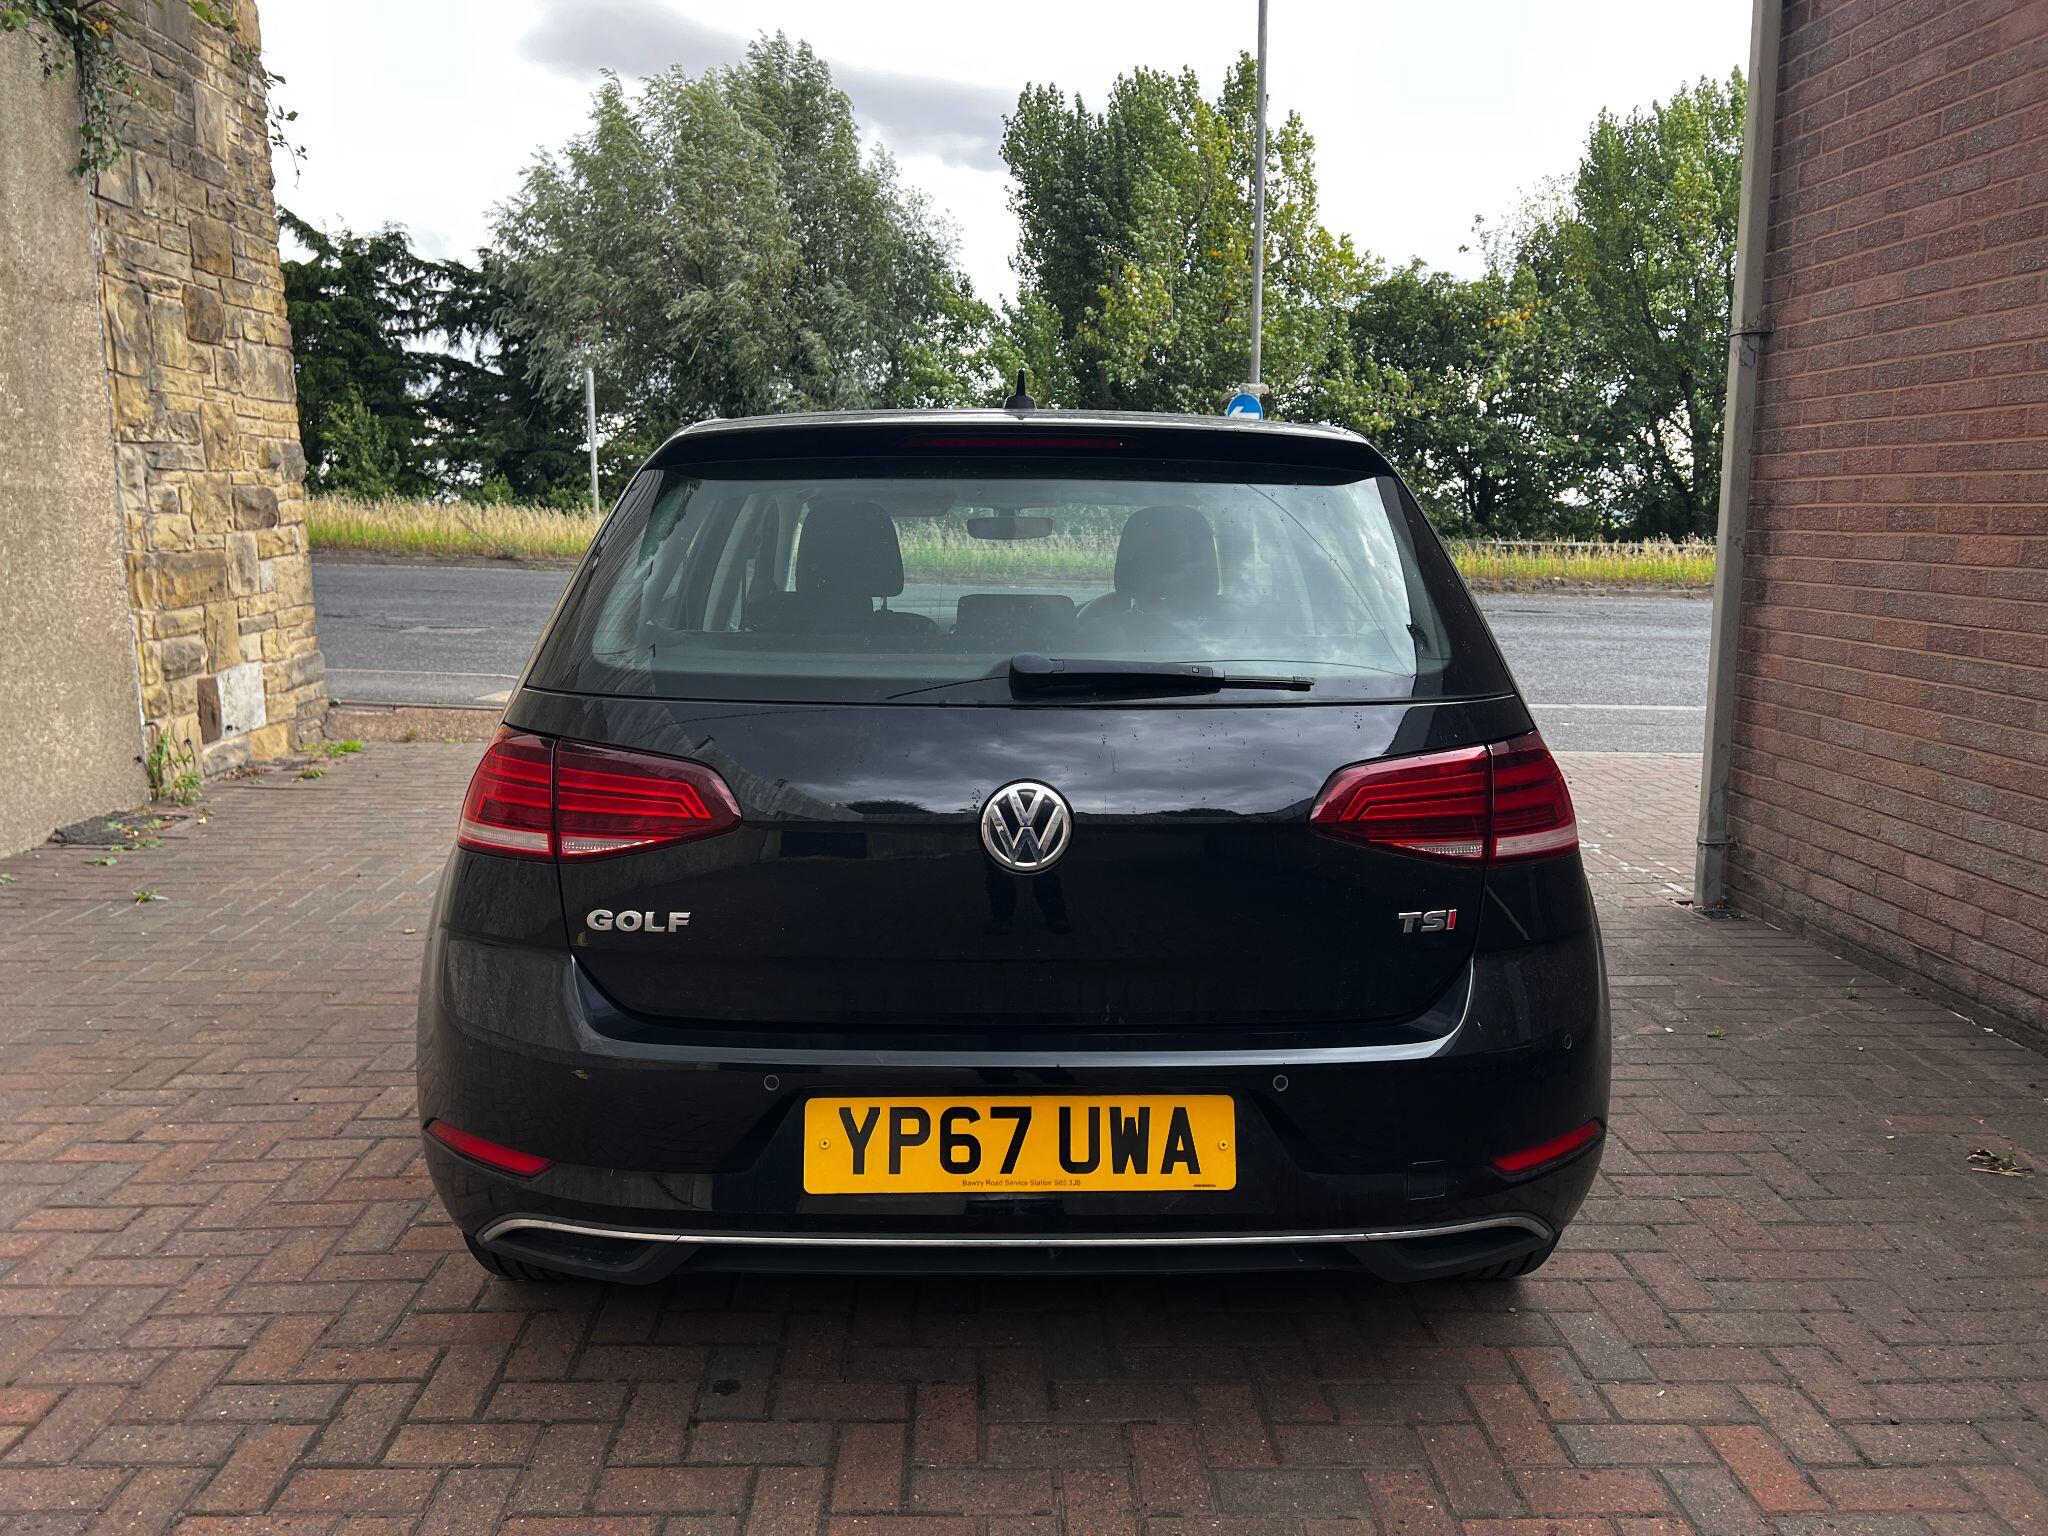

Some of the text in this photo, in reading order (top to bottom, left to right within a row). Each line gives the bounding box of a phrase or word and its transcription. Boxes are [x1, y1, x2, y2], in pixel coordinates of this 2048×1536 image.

[985, 784, 1068, 868] VW
[586, 909, 691, 932] GOLF
[838, 1106, 1201, 1175] YP67 UWA
[962, 1180, 984, 1188] Bawtry
[1030, 1179, 1052, 1187] Station
